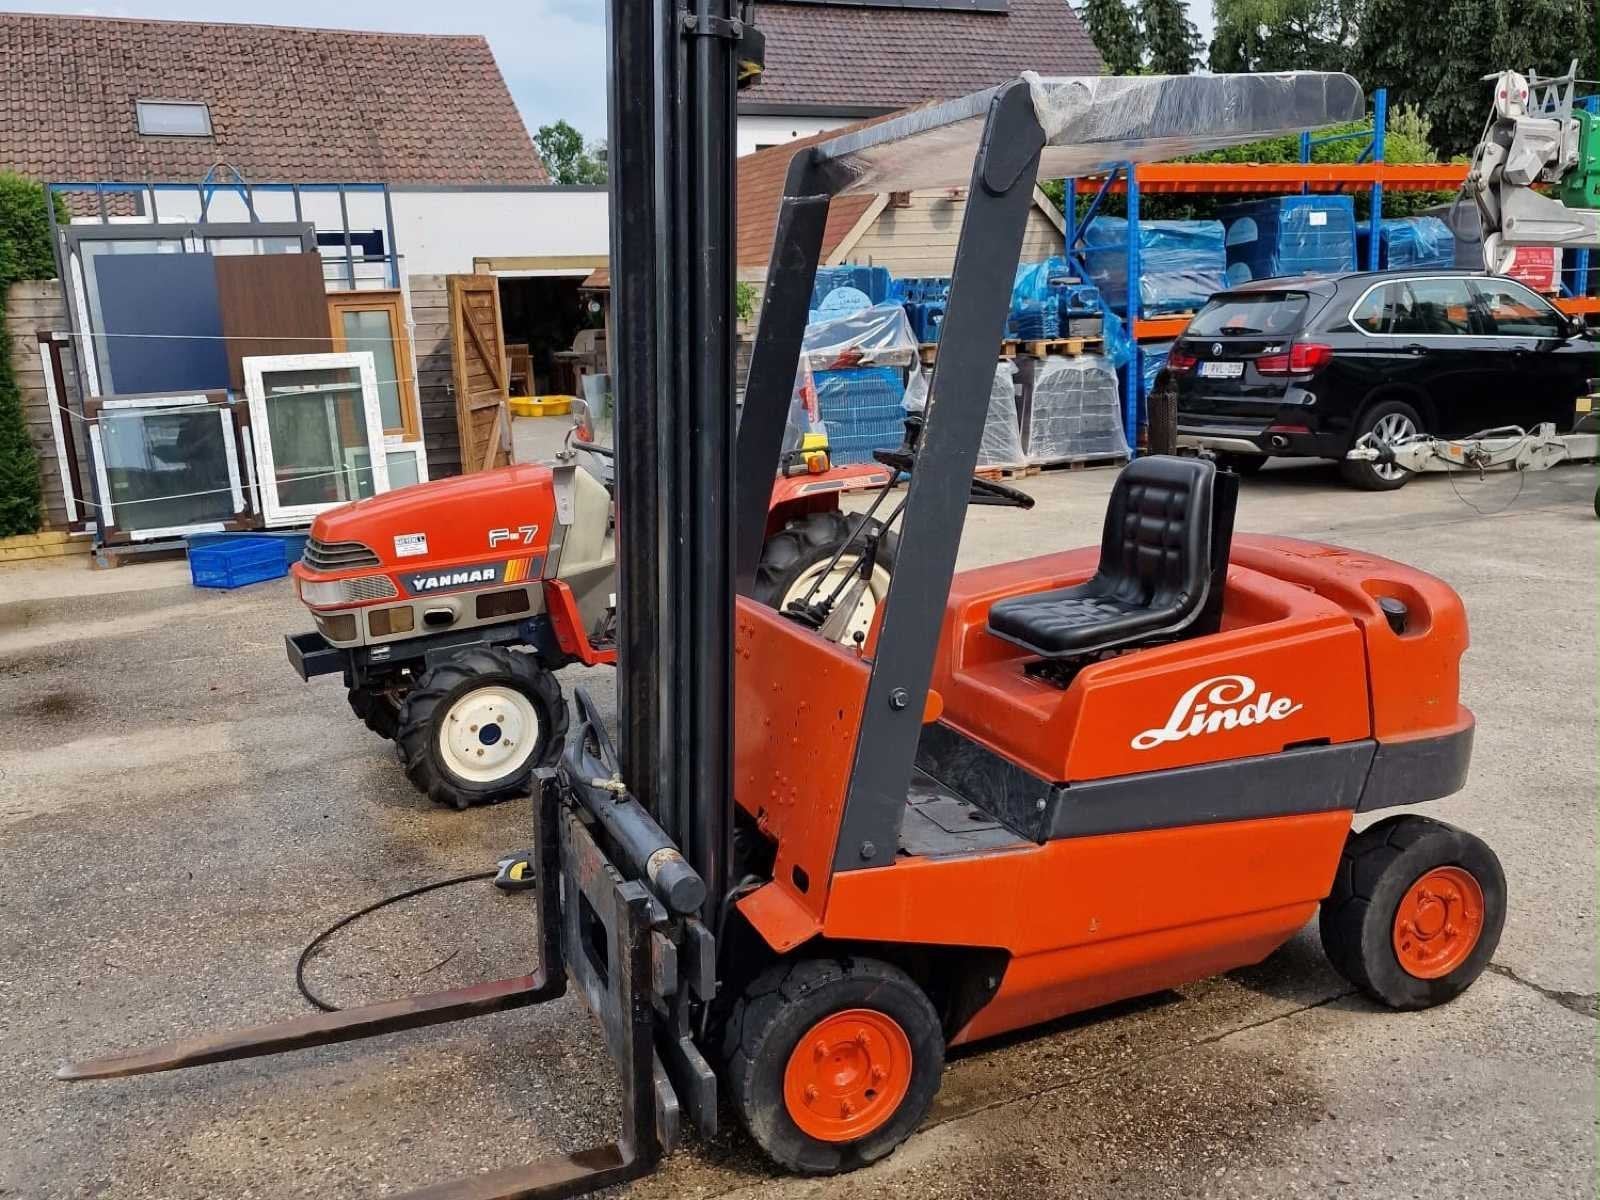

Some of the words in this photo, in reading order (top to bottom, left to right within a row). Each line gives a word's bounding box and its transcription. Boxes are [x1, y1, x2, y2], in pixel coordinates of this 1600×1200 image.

[489, 525, 539, 548] F-7
[412, 568, 496, 591] YANMAR
[1131, 675, 1303, 750] Linde
